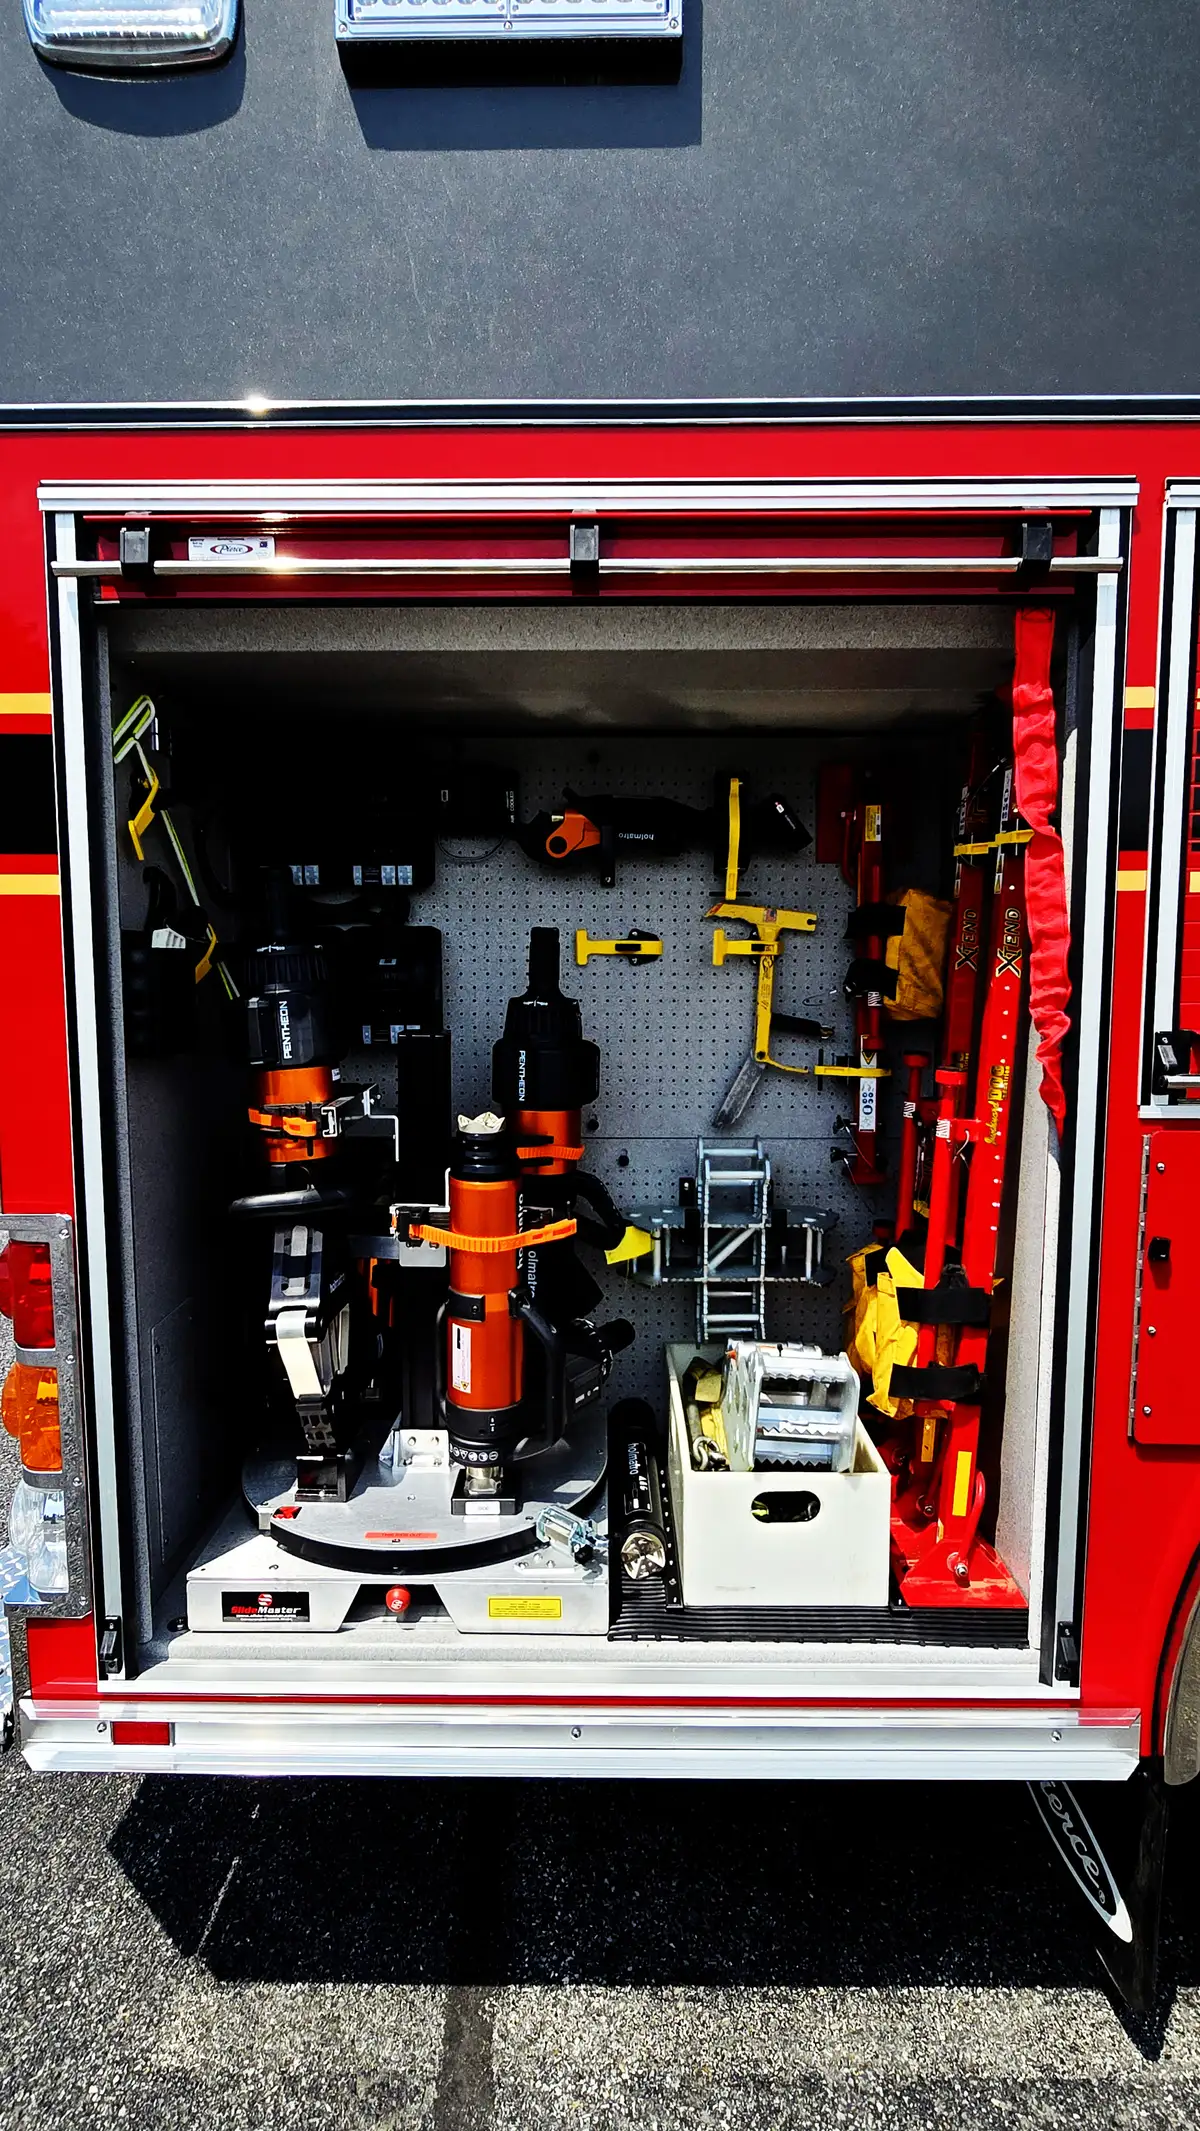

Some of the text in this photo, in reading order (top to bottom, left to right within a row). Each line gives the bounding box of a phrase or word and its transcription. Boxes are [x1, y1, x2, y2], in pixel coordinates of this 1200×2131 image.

[618, 832, 655, 841] holmatro
[954, 908, 979, 972] XTEND
[995, 907, 1022, 979] XTEND
[278, 1000, 293, 1060] PENTHEON
[518, 1049, 526, 1102] PENTHEON
[527, 1250, 539, 1298] olmatr
[627, 1442, 641, 1475] holmatro
[230, 1605, 302, 1614] SlideMaster
[1040, 1781, 1100, 1889] ierce
